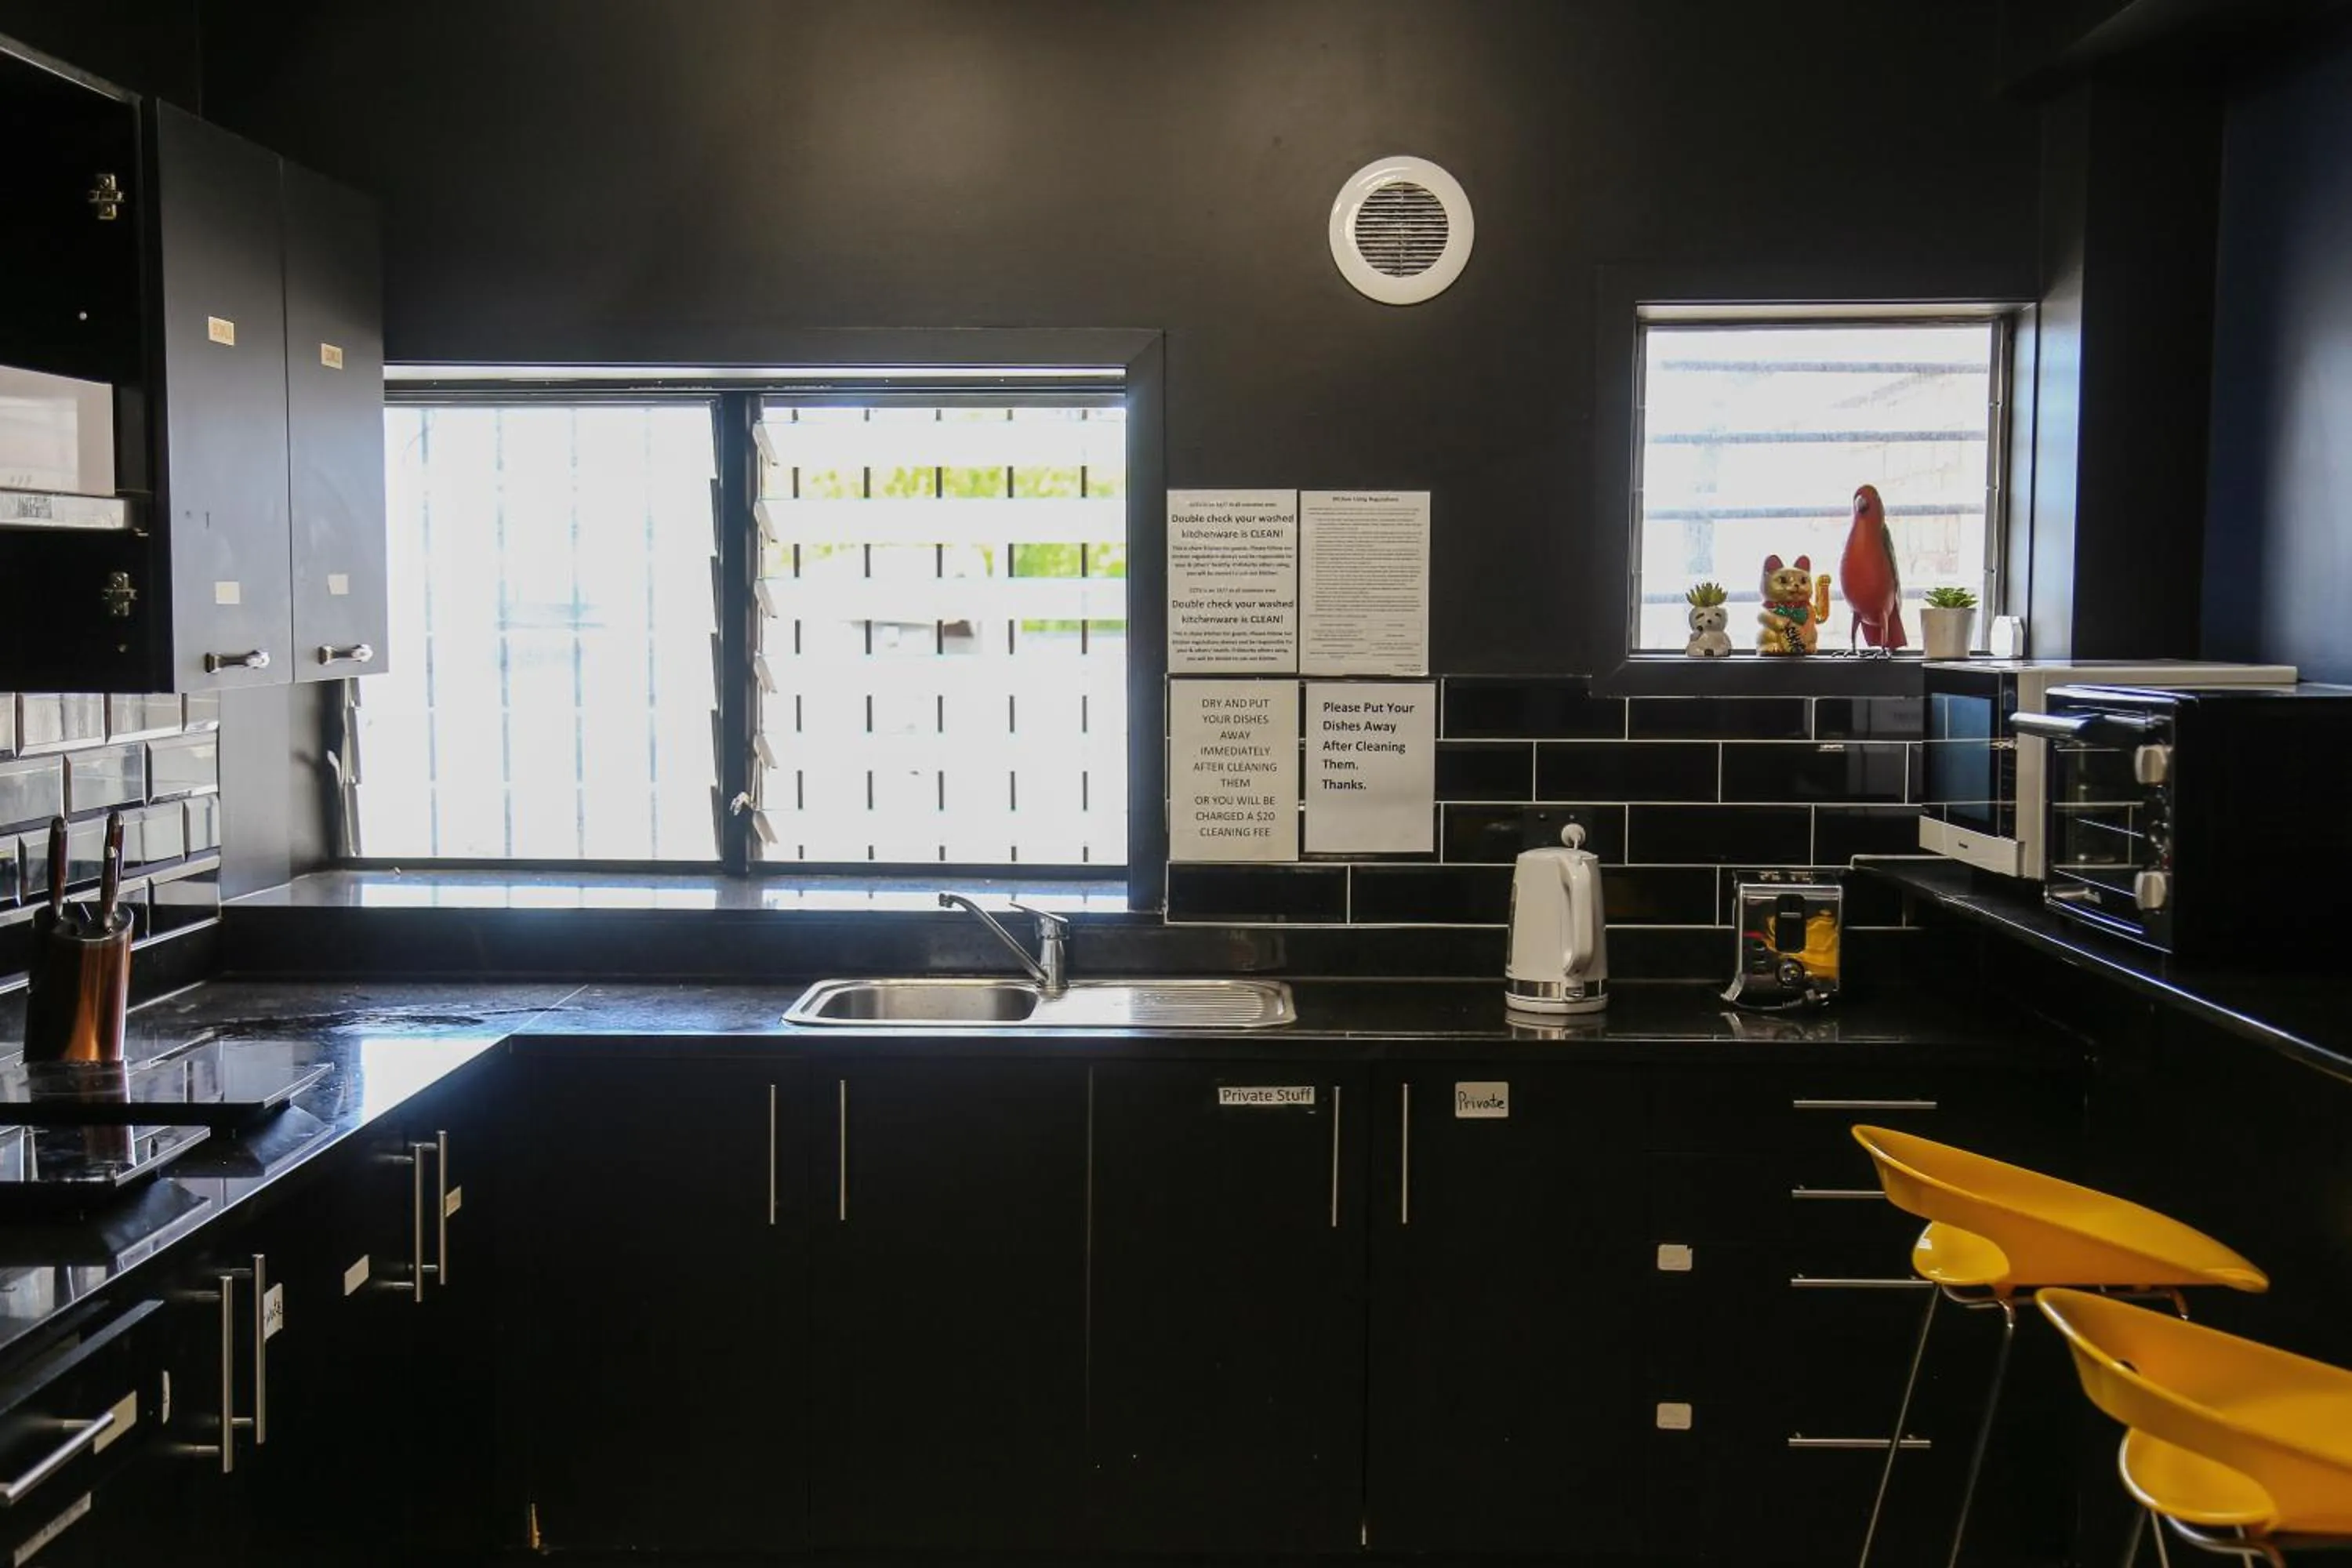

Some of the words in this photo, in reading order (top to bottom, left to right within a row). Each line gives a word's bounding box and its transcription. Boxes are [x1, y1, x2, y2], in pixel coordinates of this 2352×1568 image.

[1172, 514, 1205, 523] Double
[1207, 514, 1232, 523] check
[1235, 515, 1256, 524] your
[1258, 514, 1294, 523] washed
[1181, 530, 1239, 539] kitchenware
[1241, 530, 1248, 539] is
[1250, 530, 1283, 539] CLEAN!
[1172, 599, 1205, 609] Double
[1207, 599, 1232, 608] check
[1235, 601, 1256, 609] your
[1258, 599, 1294, 608] washed
[1181, 615, 1239, 624] kitchenware
[1241, 615, 1248, 624] is
[1250, 615, 1283, 624] CLEAN!
[1202, 699, 1221, 708] DRY
[1225, 699, 1247, 708] AND
[1249, 699, 1271, 708] PUT
[1323, 702, 1360, 713] Please
[1363, 702, 1384, 713] Put
[1387, 702, 1414, 713] Your
[1202, 714, 1231, 724] YOUR
[1233, 714, 1269, 724] DISHES
[1323, 720, 1361, 731] Dishes
[1364, 720, 1396, 734] Away
[1219, 730, 1250, 740] AWAY
[1200, 746, 1271, 757] IMMEDIATELY
[1323, 740, 1352, 751] After
[1356, 741, 1406, 755] Cleaning
[1193, 762, 1224, 771] AFTER
[1227, 762, 1277, 771] CLEANING
[1323, 758, 1359, 770] Them.
[1220, 779, 1250, 787] THEM
[1322, 779, 1367, 790] Thanks.
[1194, 796, 1210, 805] OR
[1211, 796, 1233, 805] YOU
[1236, 796, 1261, 805] WILL
[1263, 796, 1276, 805] BE
[1196, 811, 1244, 821] CHARGED
[1247, 811, 1254, 821] A
[1257, 811, 1276, 822] $20
[1200, 827, 1250, 837] CLEANING
[1254, 827, 1271, 837] FEE
[1222, 1089, 1272, 1102] Private
[1277, 1088, 1312, 1102] Stuff
[1457, 1091, 1506, 1110] Private
